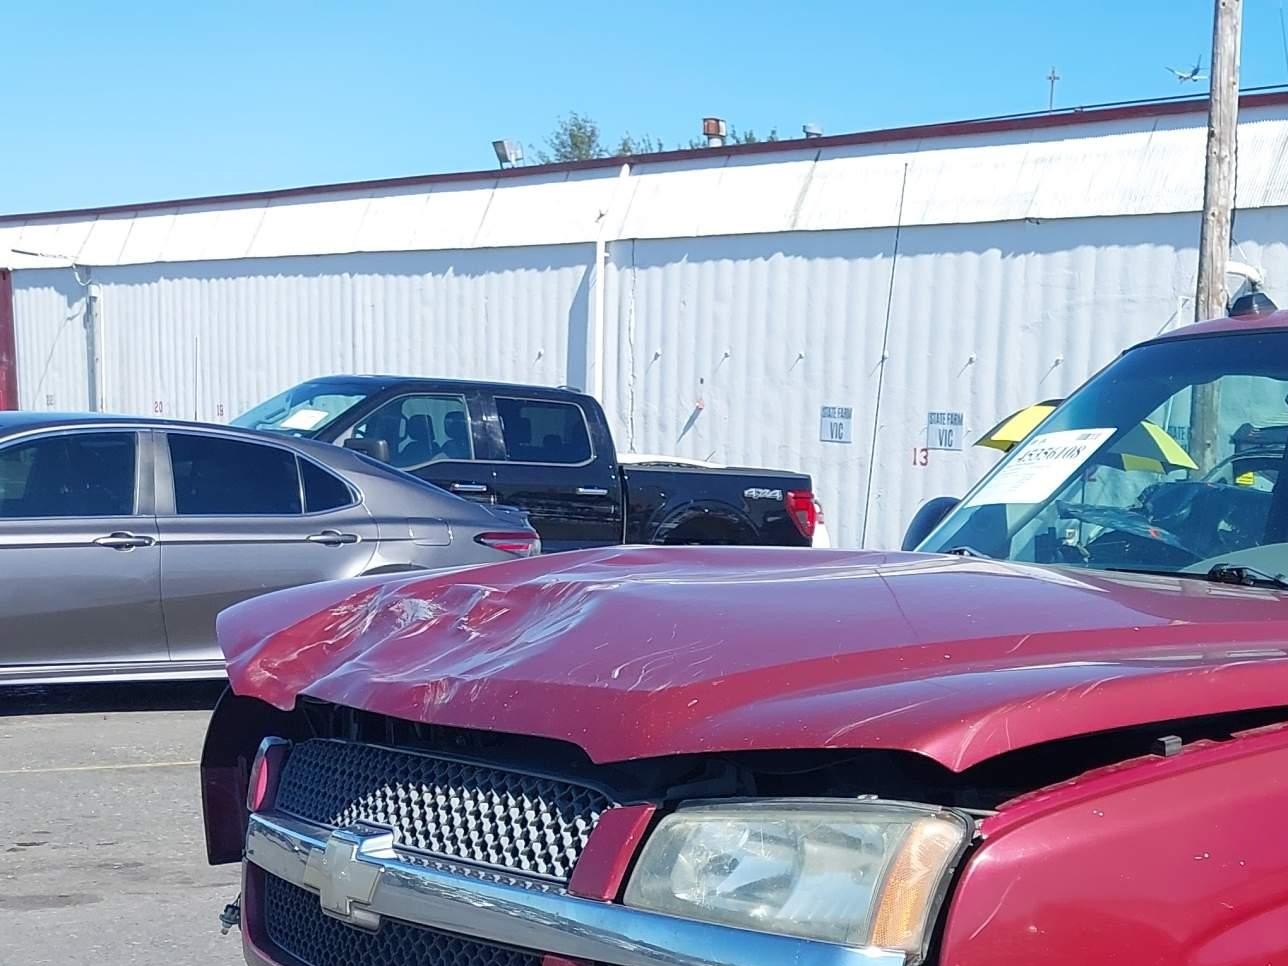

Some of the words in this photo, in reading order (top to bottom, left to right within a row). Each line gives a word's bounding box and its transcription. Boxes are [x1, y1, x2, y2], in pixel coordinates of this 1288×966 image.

[822, 407, 837, 419] STATE
[929, 413, 946, 426] STATE
[947, 413, 964, 427] FARM
[830, 422, 844, 441] VIC
[938, 429, 954, 448] VIC
[912, 448, 928, 466] 13
